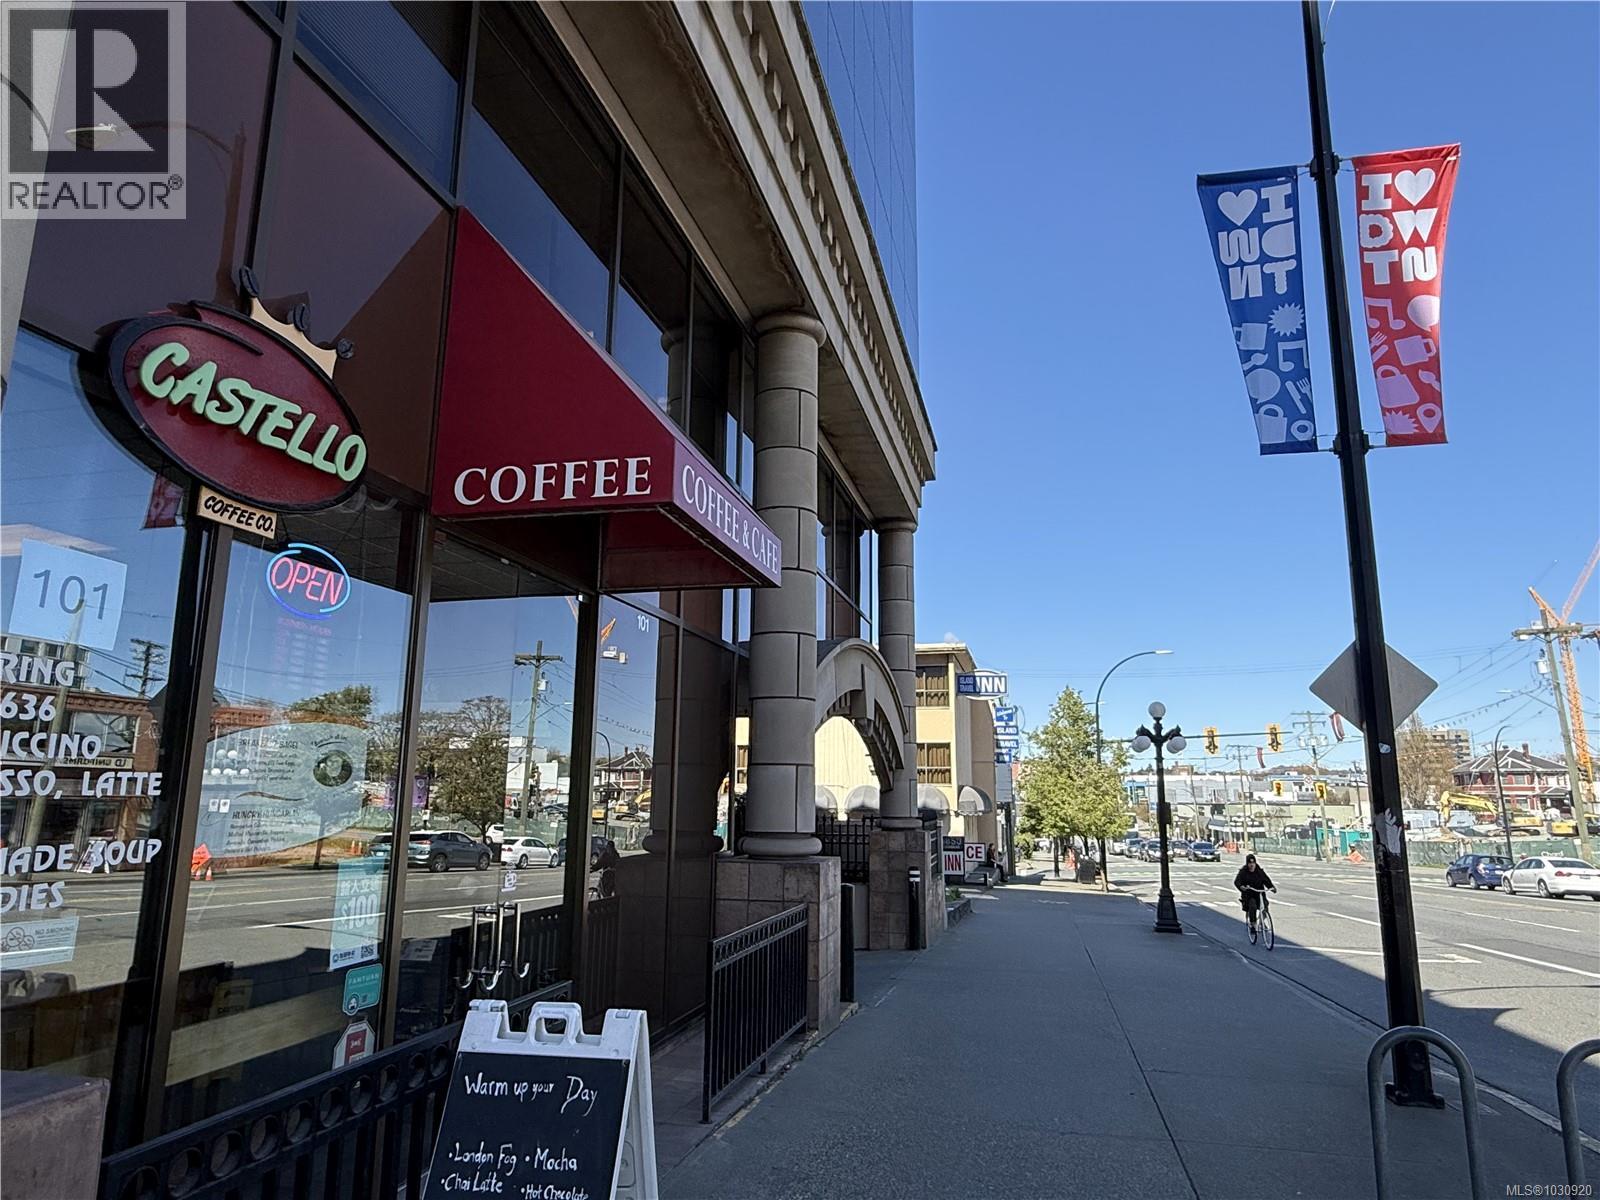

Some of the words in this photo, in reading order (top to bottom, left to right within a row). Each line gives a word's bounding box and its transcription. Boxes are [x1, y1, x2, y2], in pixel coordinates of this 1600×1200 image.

[1362, 172, 1392, 210] I
[140, 342, 367, 482] CASTELLO
[454, 457, 651, 506] COFFEE
[204, 496, 256, 526] COFFEE
[256, 514, 273, 532] CO.
[682, 465, 739, 543] COFFEE
[742, 520, 750, 549] &
[751, 527, 778, 574] CAFE
[33, 569, 109, 620] 101
[271, 557, 344, 605] OPEN
[637, 615, 649, 632] 101
[976, 676, 1006, 693] INN
[0, 692, 56, 721] 636
[81, 771, 163, 799] LATTE
[91, 839, 162, 867] SOUP
[944, 854, 961, 871] INN
[966, 846, 983, 859] CE
[465, 1072, 508, 1096] Warm
[513, 1081, 528, 1102] up
[532, 1082, 554, 1100] your
[560, 1075, 598, 1117] Day
[497, 1143, 517, 1176] Fog
[534, 1148, 578, 1171] Mocha
[444, 1172, 471, 1192] Chai
[472, 1171, 503, 1193] Latte
[525, 1184, 542, 1200] Hot
